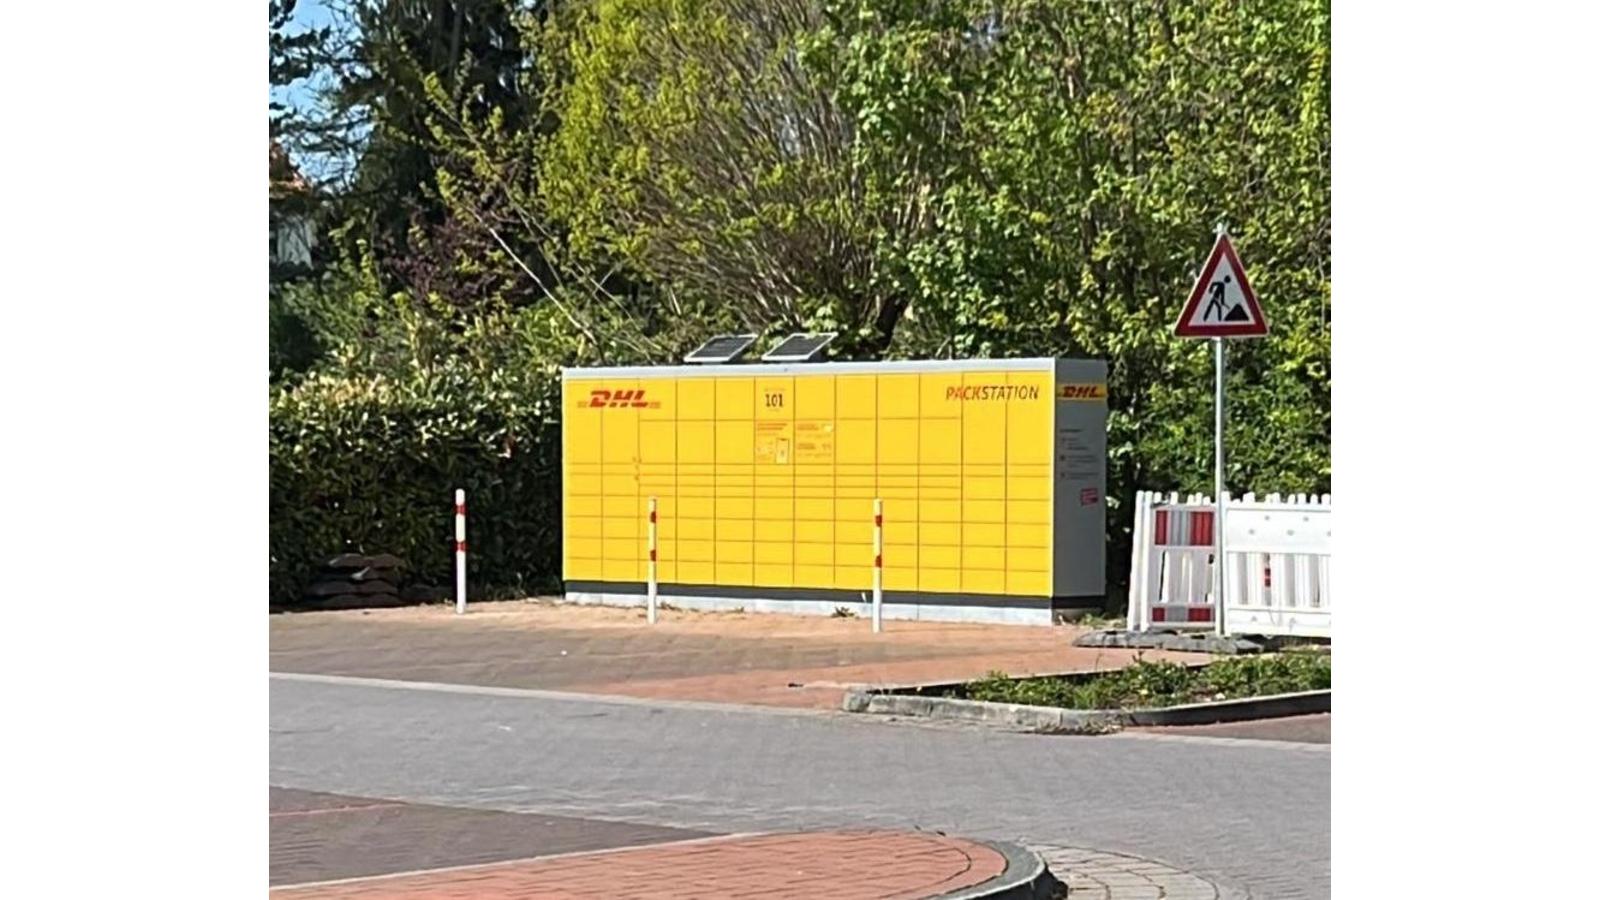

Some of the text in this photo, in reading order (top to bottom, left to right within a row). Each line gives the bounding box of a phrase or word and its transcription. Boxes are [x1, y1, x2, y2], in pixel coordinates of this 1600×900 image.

[590, 390, 648, 408] DHL
[945, 385, 1039, 400] PACKSTATION
[1063, 385, 1099, 398] DHL
[765, 393, 783, 408] 101
